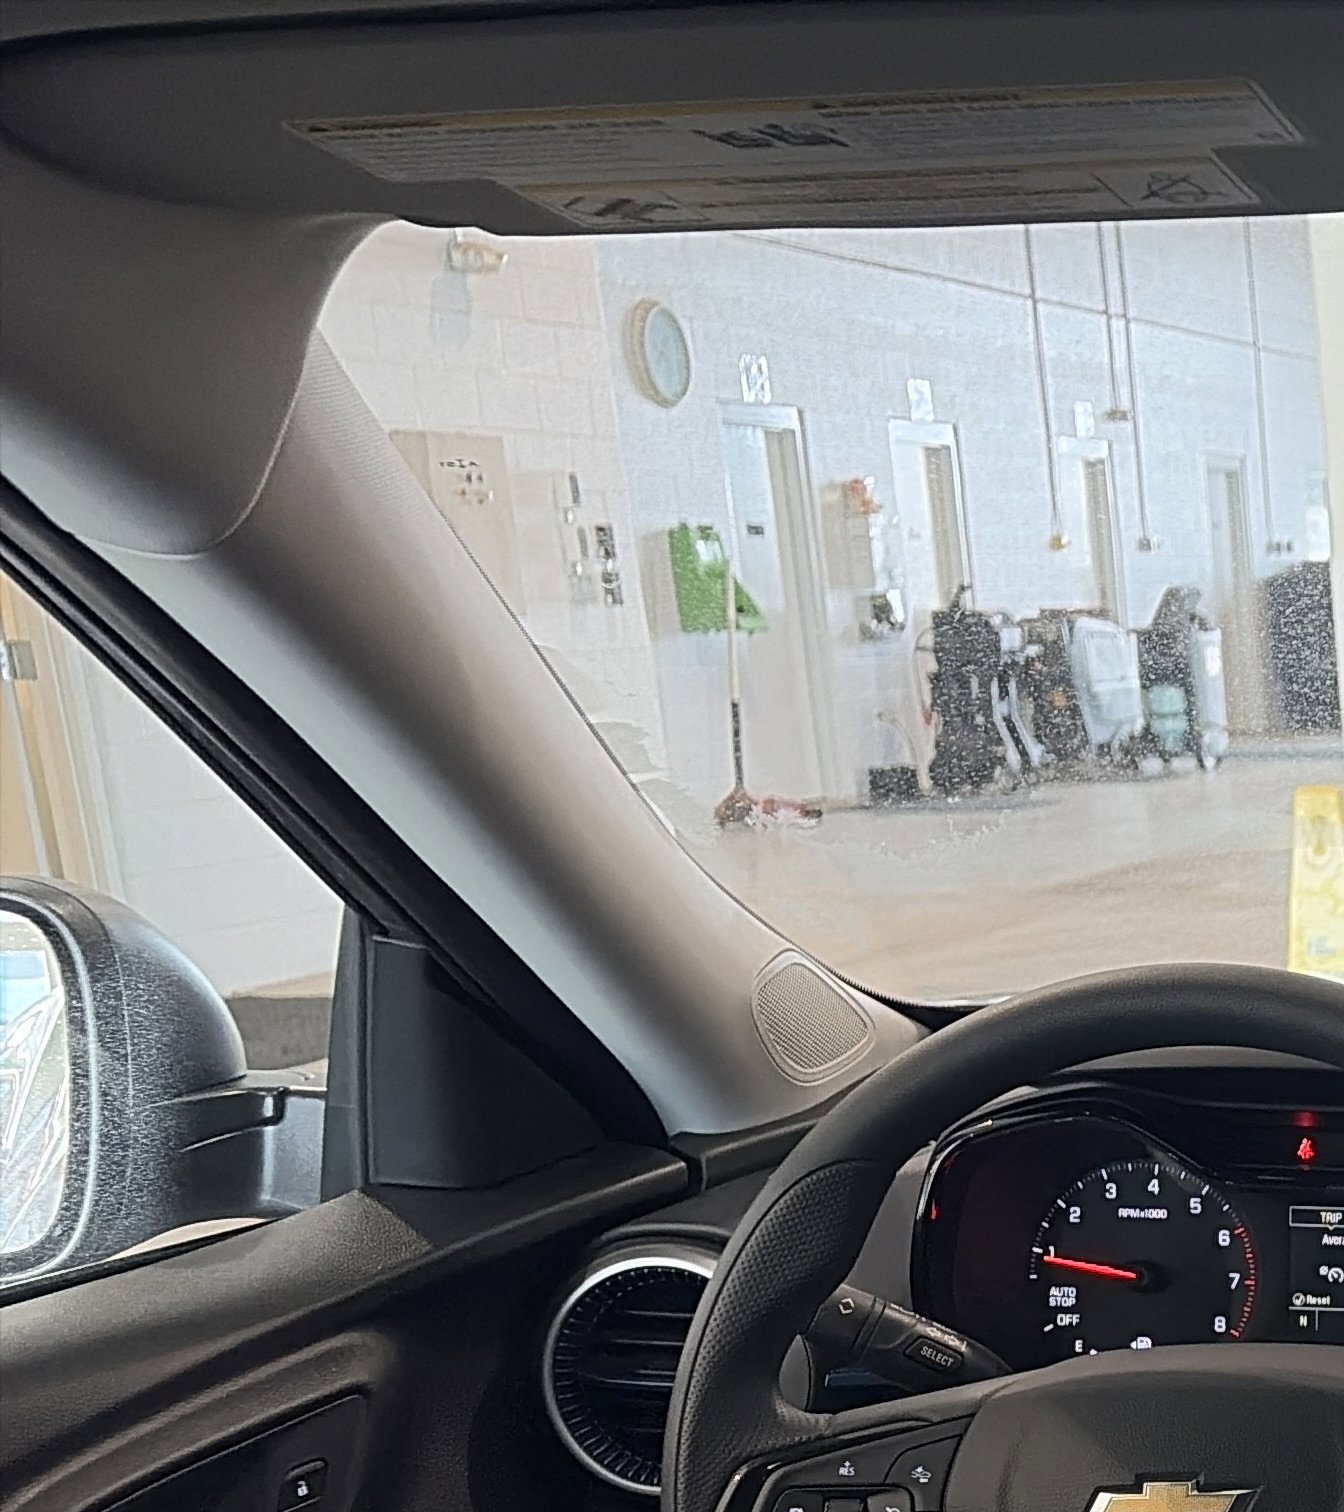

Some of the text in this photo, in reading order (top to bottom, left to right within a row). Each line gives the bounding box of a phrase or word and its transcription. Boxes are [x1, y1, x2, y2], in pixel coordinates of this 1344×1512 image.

[1105, 1182, 1117, 1199] 3
[1148, 1178, 1160, 1196] 4
[1189, 1197, 1202, 1214] 5
[1069, 1206, 1081, 1223] 2
[1320, 1212, 1342, 1223] TRIP
[1218, 1229, 1231, 1247] 6
[1228, 1272, 1240, 1290] 7
[1050, 1286, 1077, 1297] AUTO
[1306, 1295, 1330, 1305] Reset
[1049, 1297, 1076, 1307] STOP
[1057, 1313, 1080, 1326] OFF
[1214, 1316, 1227, 1333] 8
[1074, 1340, 1083, 1353] E
[920, 1345, 955, 1367] SELECT
[839, 1467, 855, 1476] RES
